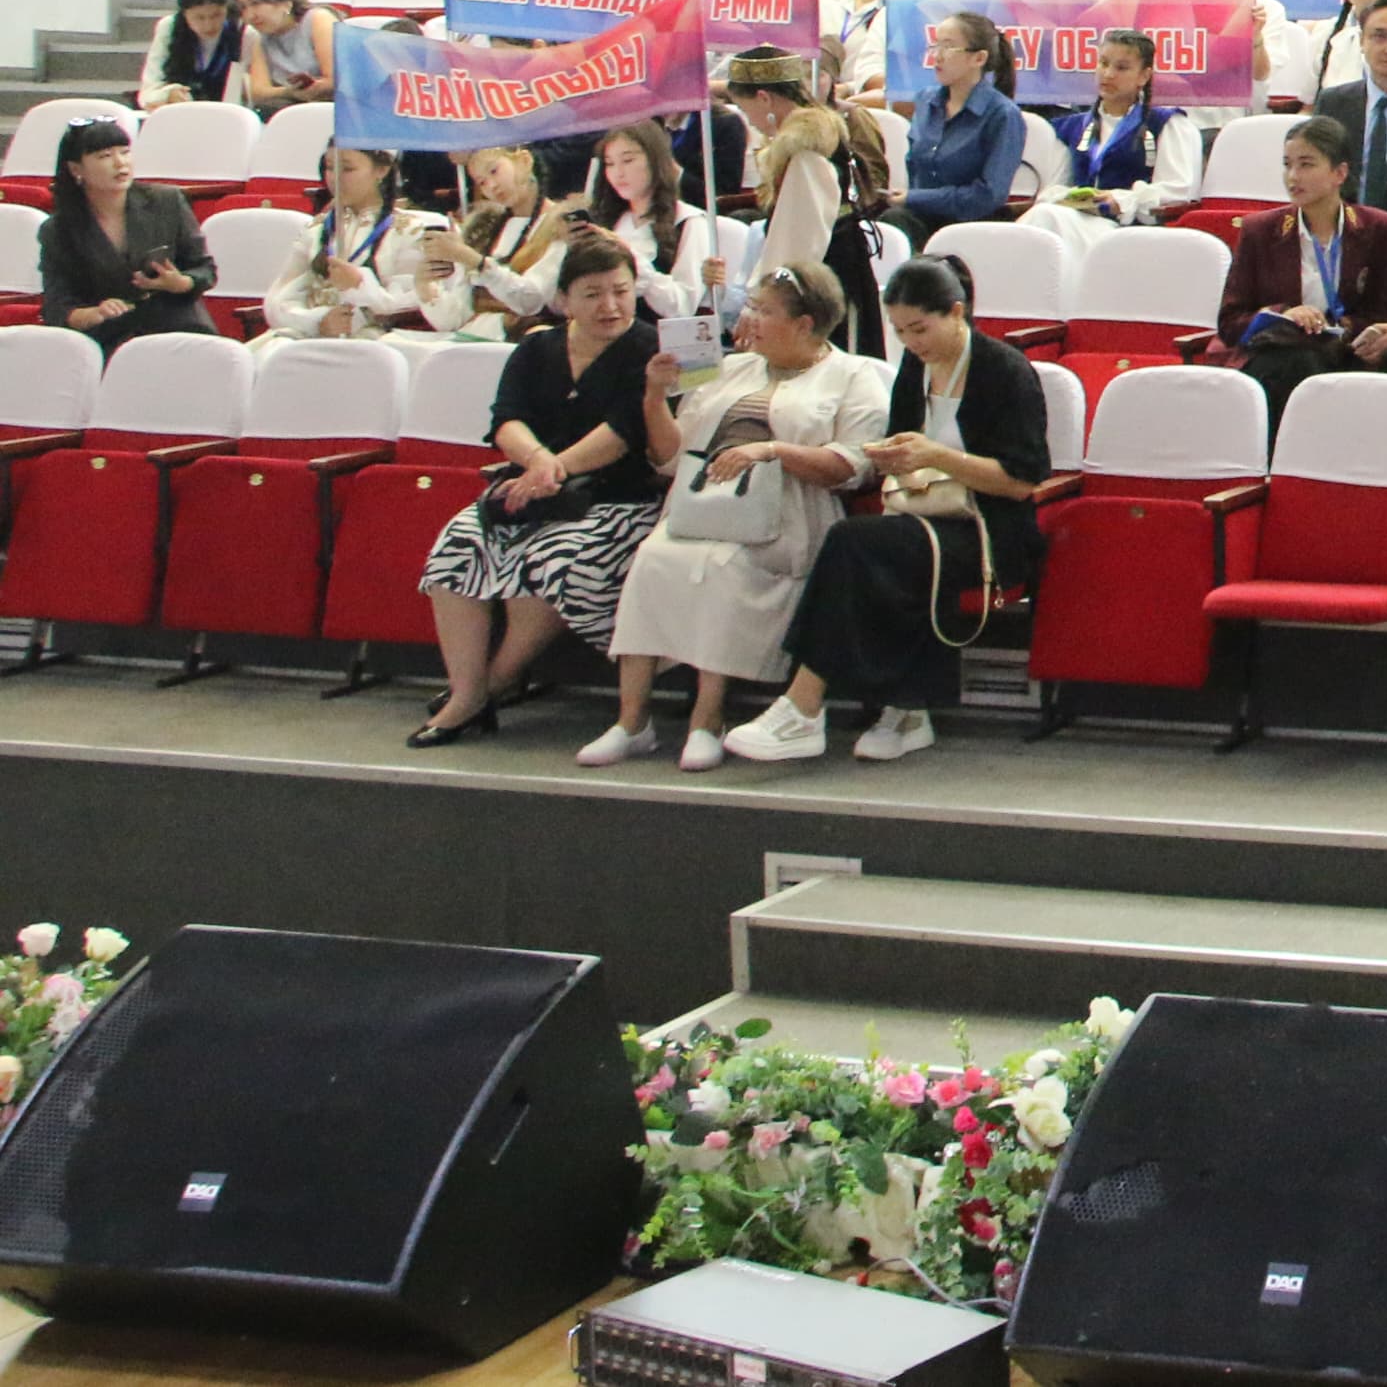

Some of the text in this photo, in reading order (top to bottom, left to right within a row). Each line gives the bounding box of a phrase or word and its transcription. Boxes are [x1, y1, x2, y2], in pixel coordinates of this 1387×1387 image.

[395, 33, 647, 122] АБАЙ ОБЛЫСЫ
[1053, 26, 1207, 73] ОБСЫ
